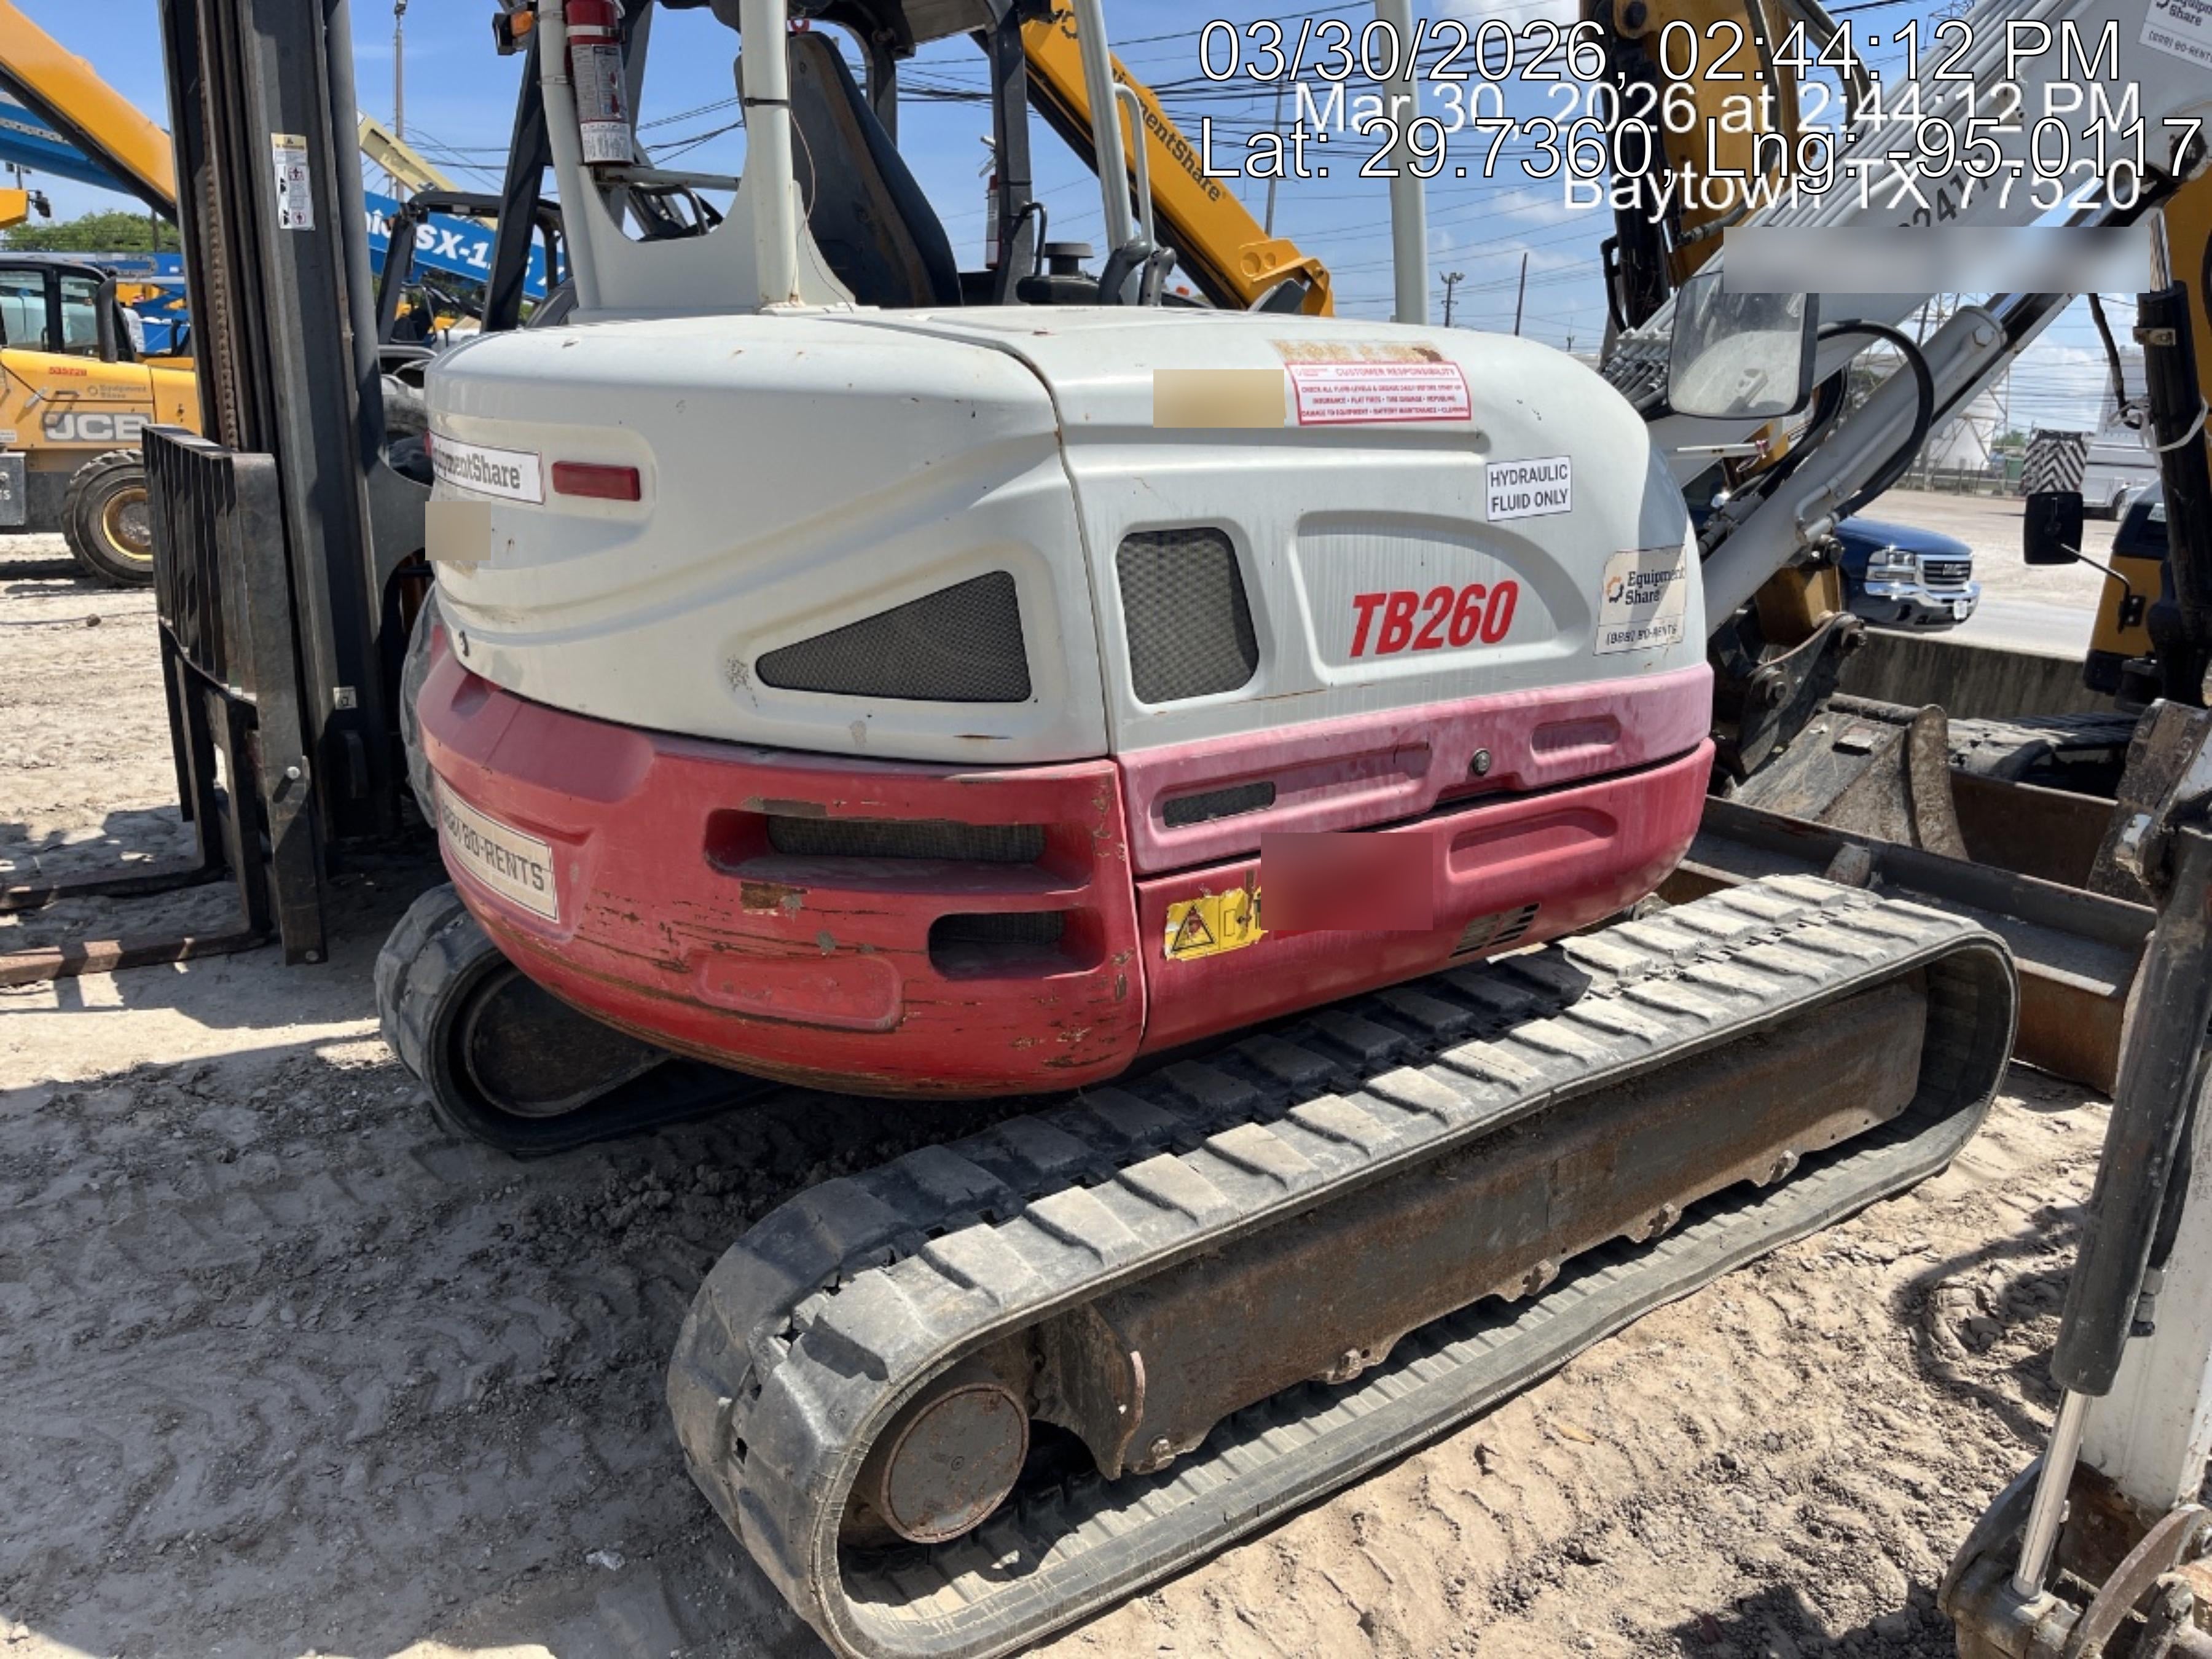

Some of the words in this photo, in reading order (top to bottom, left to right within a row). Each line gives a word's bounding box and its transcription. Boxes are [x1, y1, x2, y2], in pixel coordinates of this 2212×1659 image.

[2168, 4, 2202, 26] Share
[45, 414, 149, 440] JCB
[1490, 463, 1569, 487] HYDRAULIC
[1491, 492, 1531, 513] FLUID
[1534, 488, 1569, 508] ONLY
[1627, 565, 1685, 589] Equipment
[1625, 587, 1661, 605] Share
[1349, 579, 1520, 659] TB260
[463, 823, 544, 892] 80-RENTS
